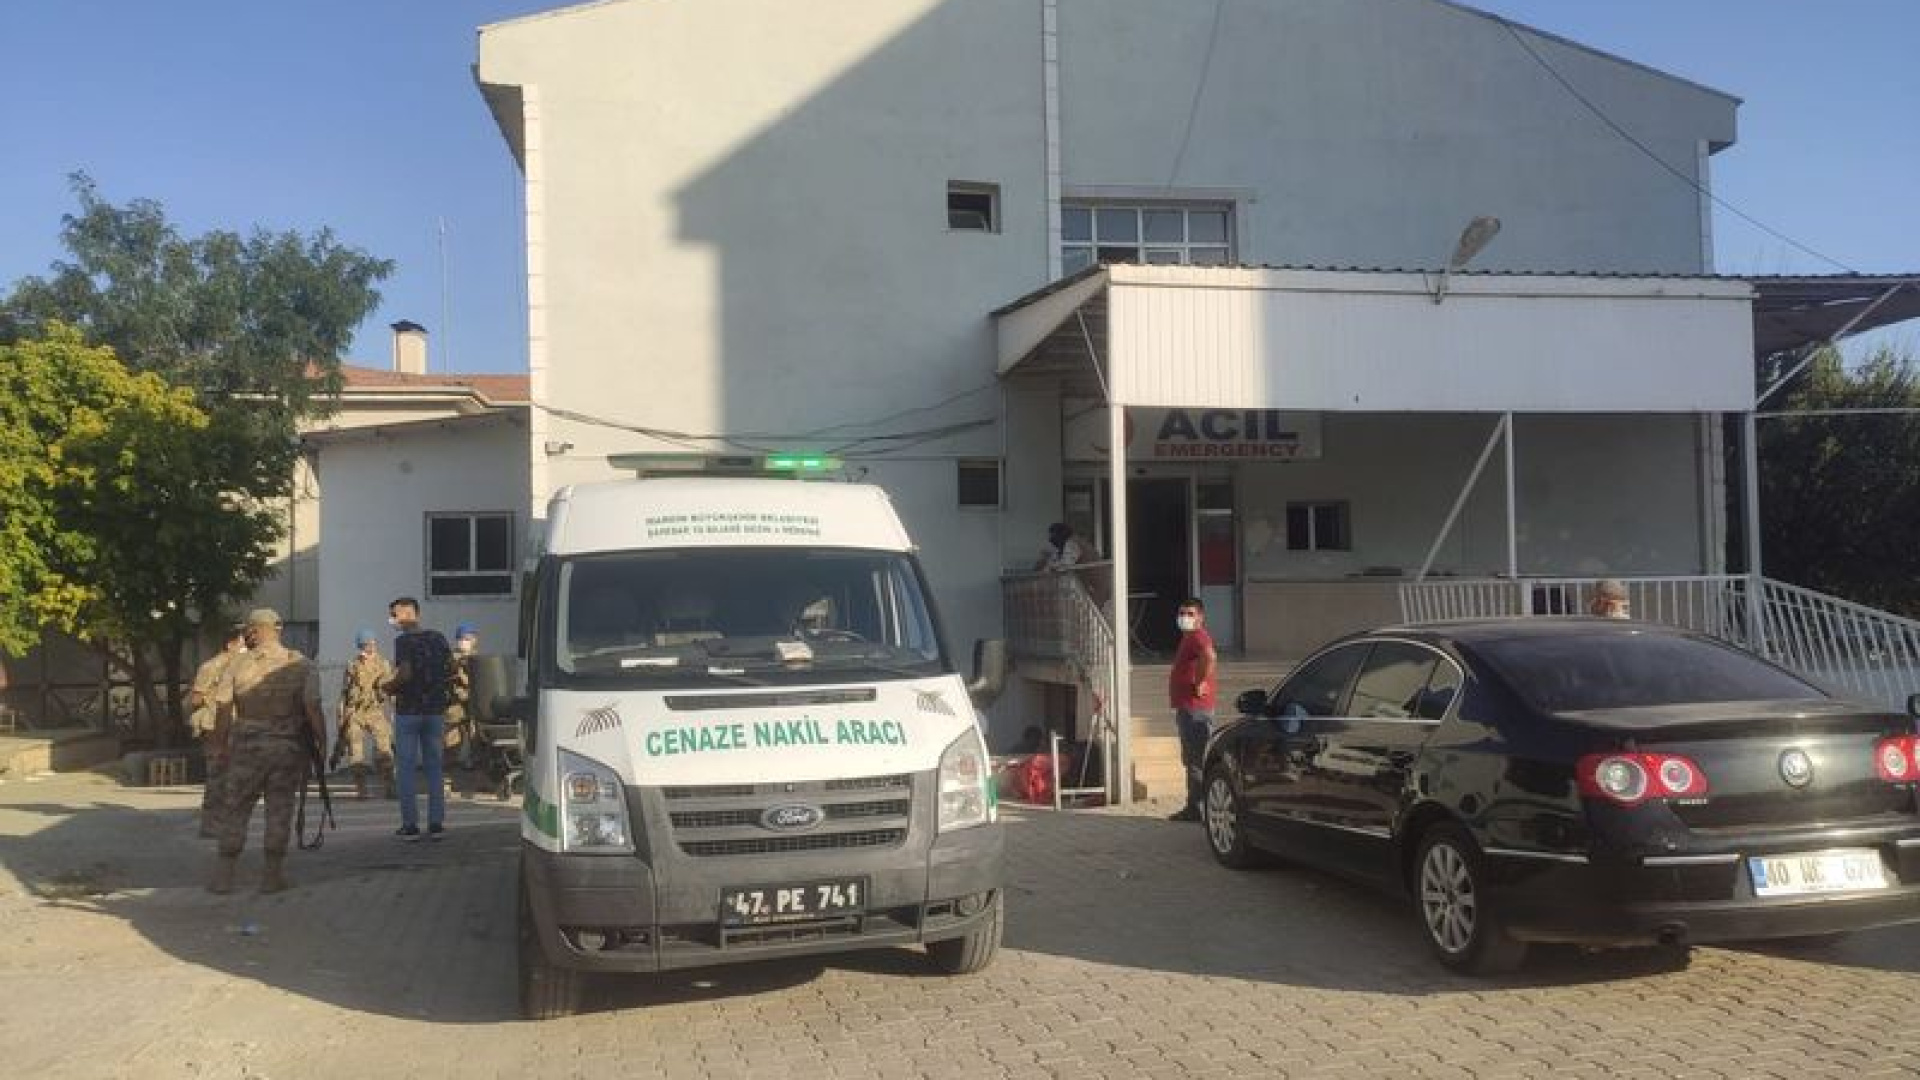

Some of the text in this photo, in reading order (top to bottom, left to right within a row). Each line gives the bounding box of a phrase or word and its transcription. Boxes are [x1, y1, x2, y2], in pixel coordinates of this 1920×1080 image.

[1153, 443, 1301, 457] EMERGENCY
[645, 715, 908, 757] CENAZE NAKİL ARACI
[736, 882, 858, 915] 47 PE 741
